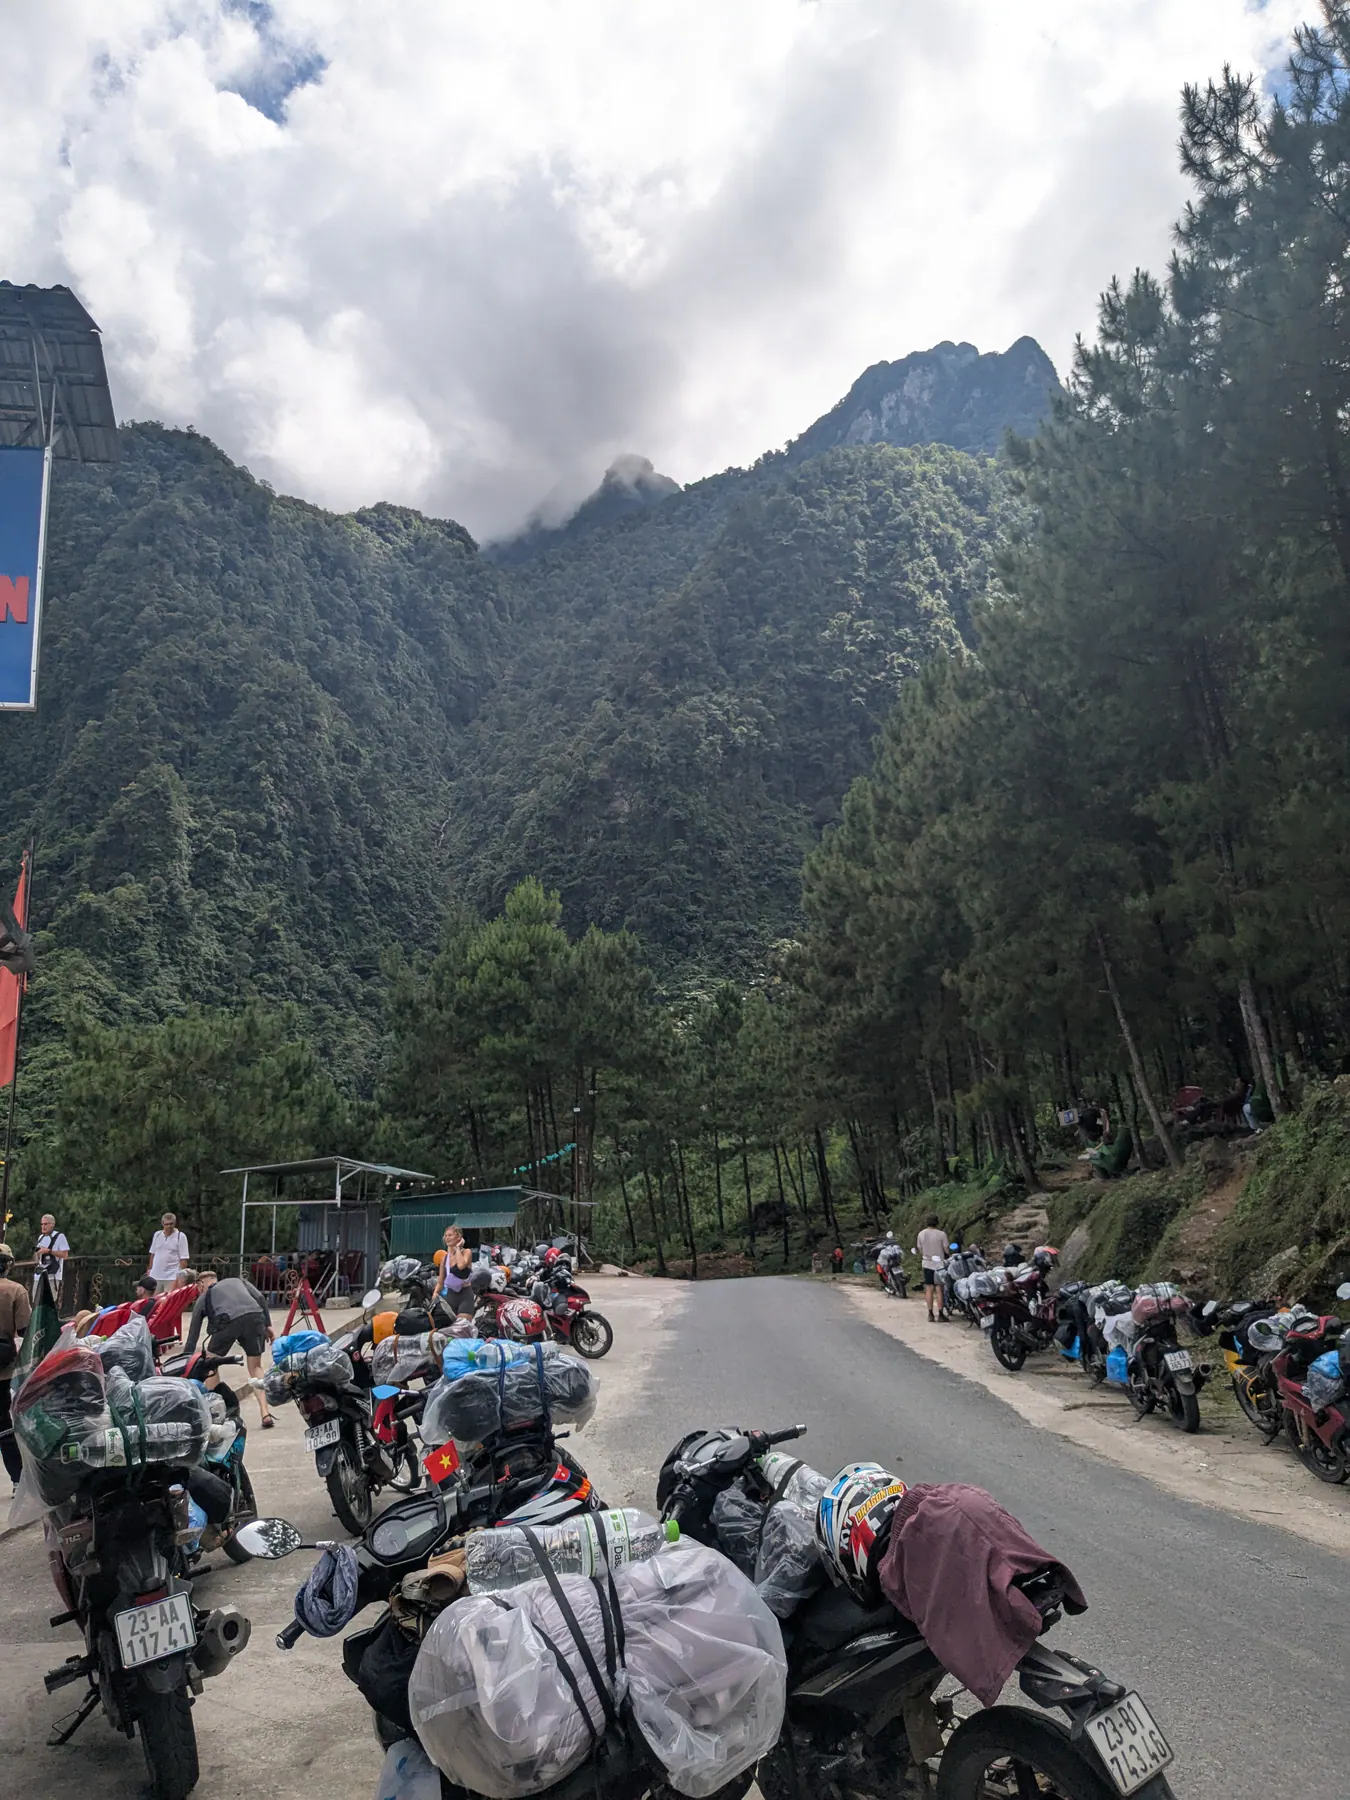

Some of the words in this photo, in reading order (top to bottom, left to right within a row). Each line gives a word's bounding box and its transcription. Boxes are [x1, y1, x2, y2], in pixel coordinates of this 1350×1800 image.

[310, 1422, 333, 1438] 23-AA
[855, 1488, 887, 1521] DRAGON
[887, 1485, 904, 1496] BOY
[128, 1600, 180, 1637] 23-AA
[126, 1622, 189, 1662] 117.41
[1097, 1701, 1145, 1751] 23-B1
[1110, 1730, 1167, 1788] 743.46
